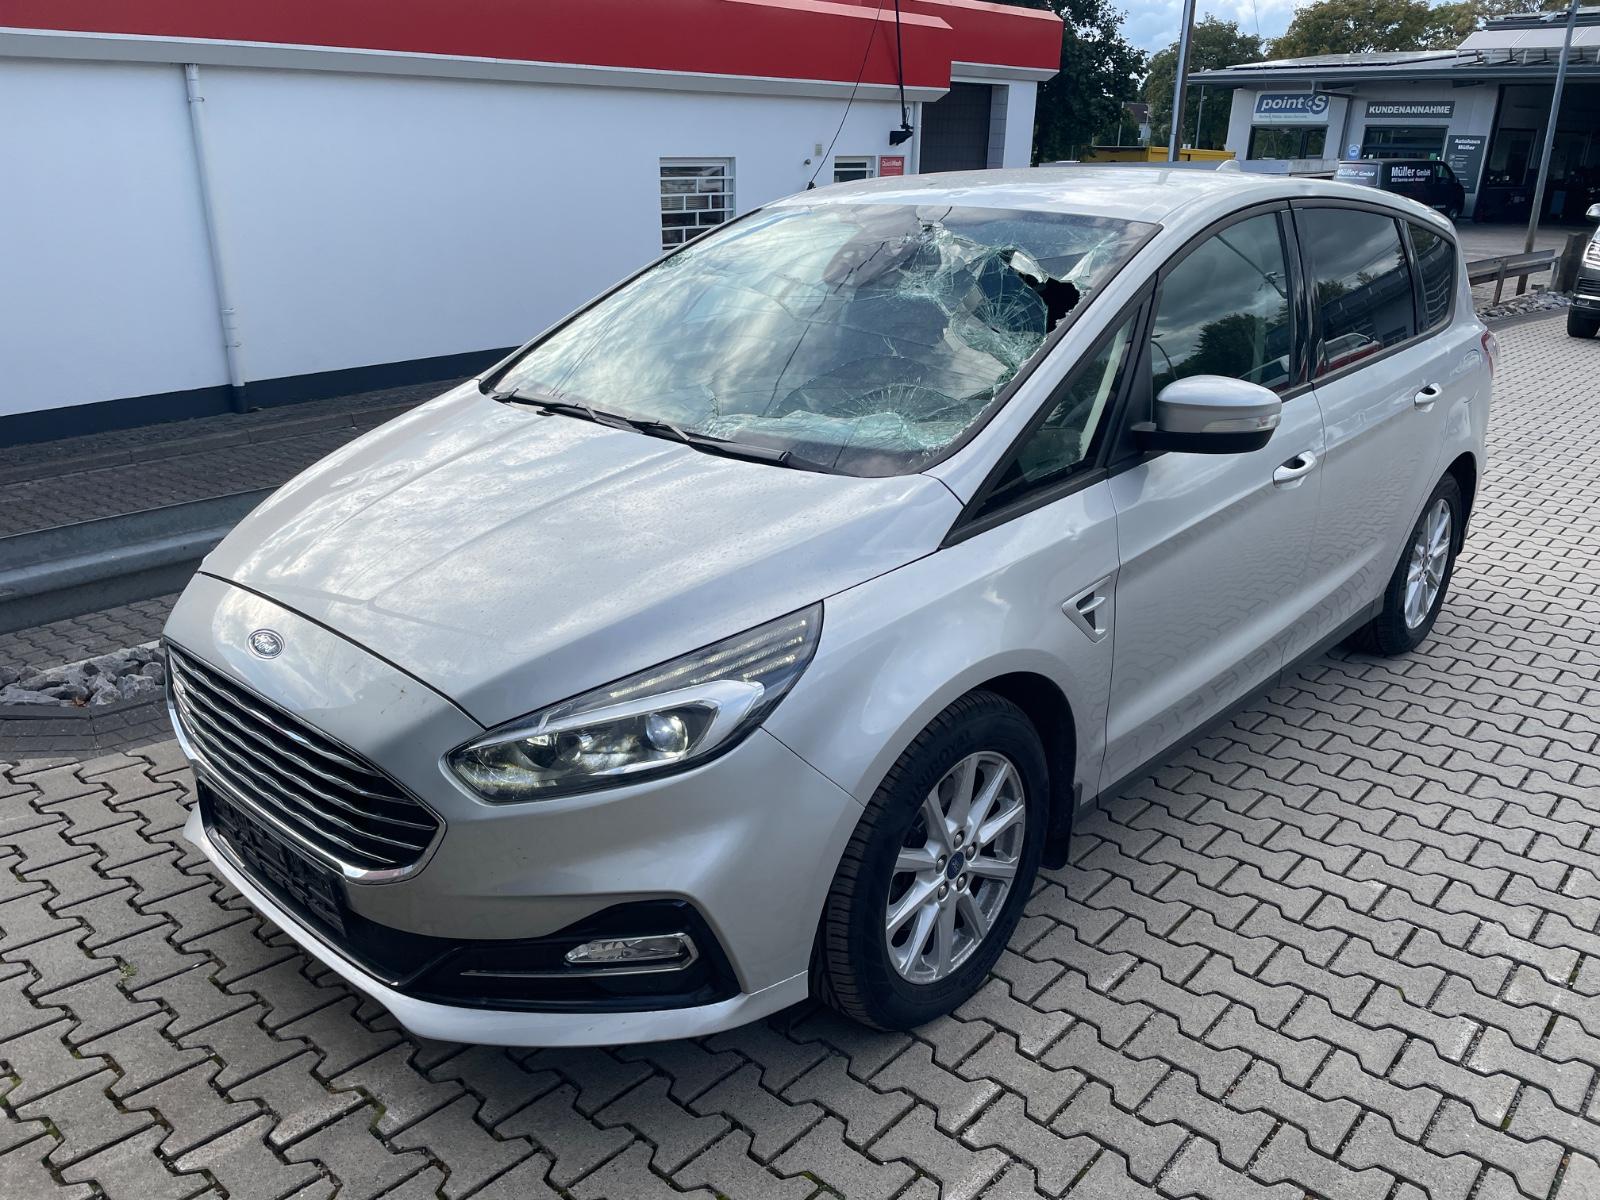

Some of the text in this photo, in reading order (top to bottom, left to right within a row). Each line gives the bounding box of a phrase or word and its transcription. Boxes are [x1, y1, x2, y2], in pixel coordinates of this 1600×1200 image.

[1261, 95, 1327, 111] point S
[1369, 105, 1451, 114] KUNDENANNAHME
[1391, 165, 1431, 177] Müller GmbH
